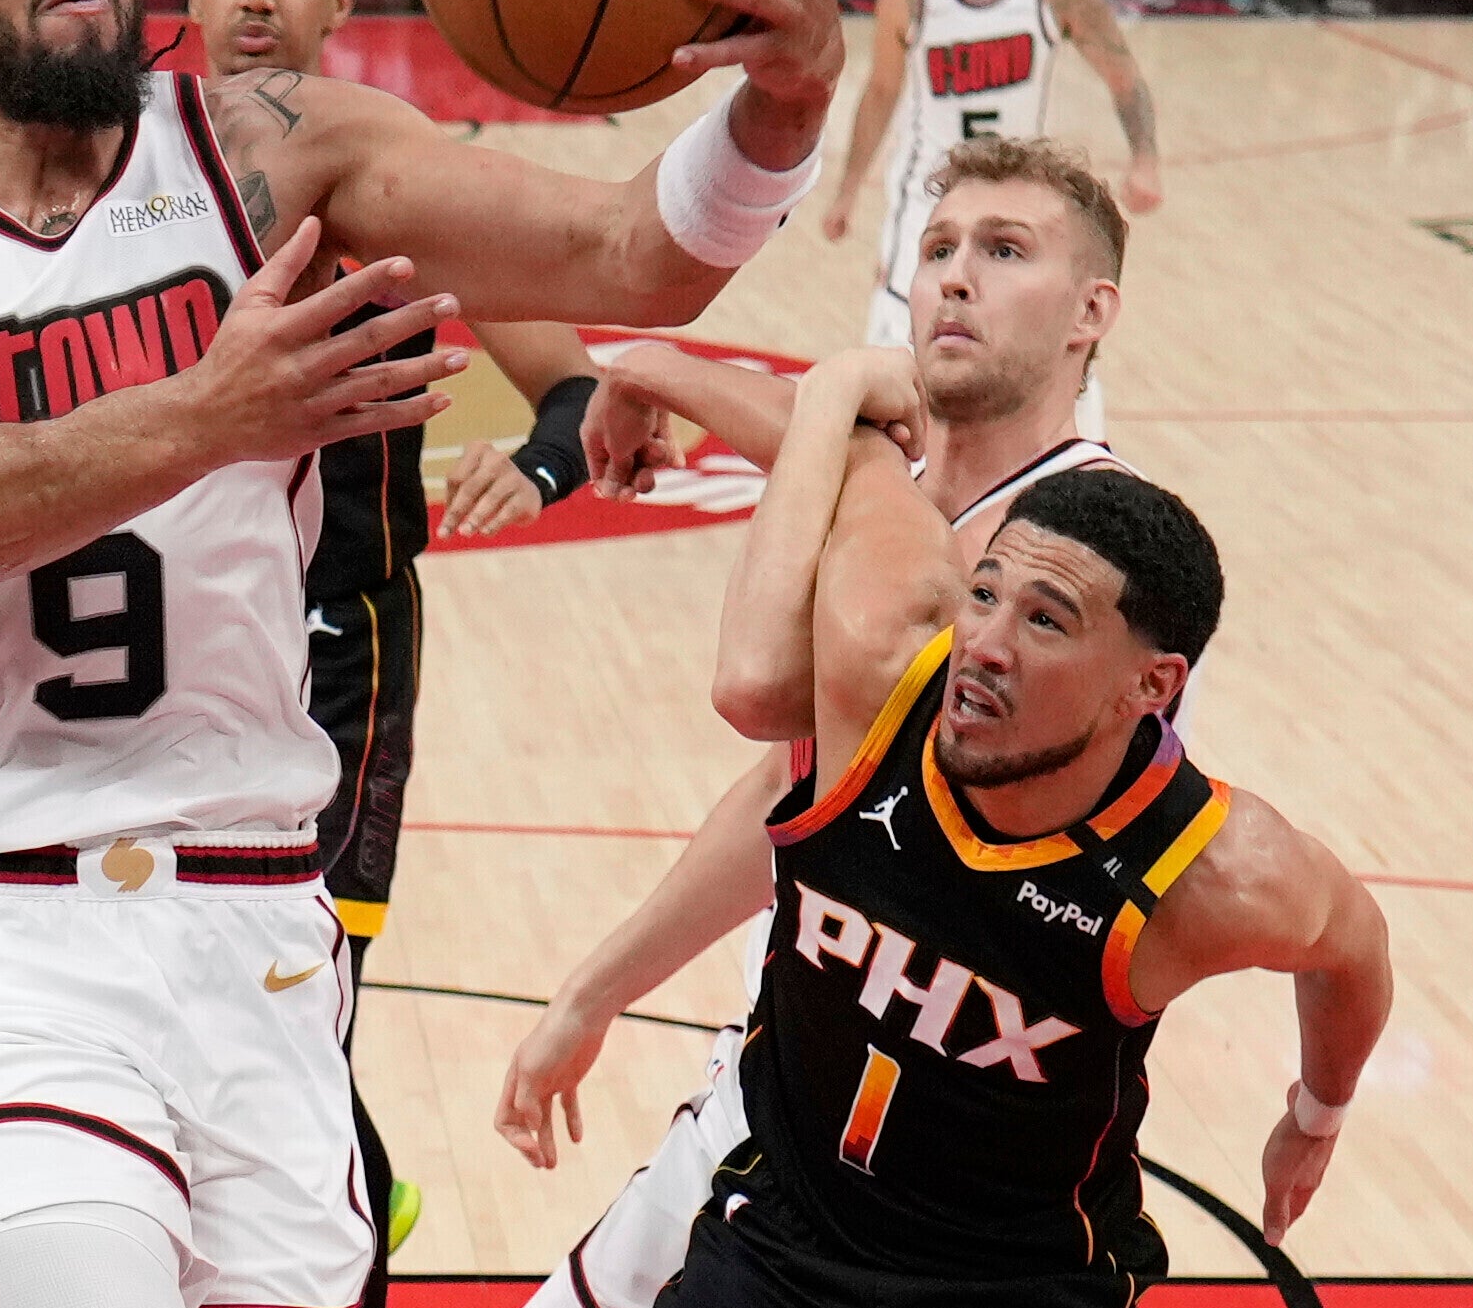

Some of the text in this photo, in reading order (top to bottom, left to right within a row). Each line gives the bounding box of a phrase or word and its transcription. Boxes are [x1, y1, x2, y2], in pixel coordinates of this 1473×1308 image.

[109, 192, 208, 220] MEMORIAL
[110, 201, 209, 233] HERMANN
[29, 531, 165, 722] 9
[1103, 856, 1123, 879] AL
[1016, 880, 1104, 936] PayPal
[793, 879, 1082, 1083] PHX
[839, 1043, 901, 1177] 1
